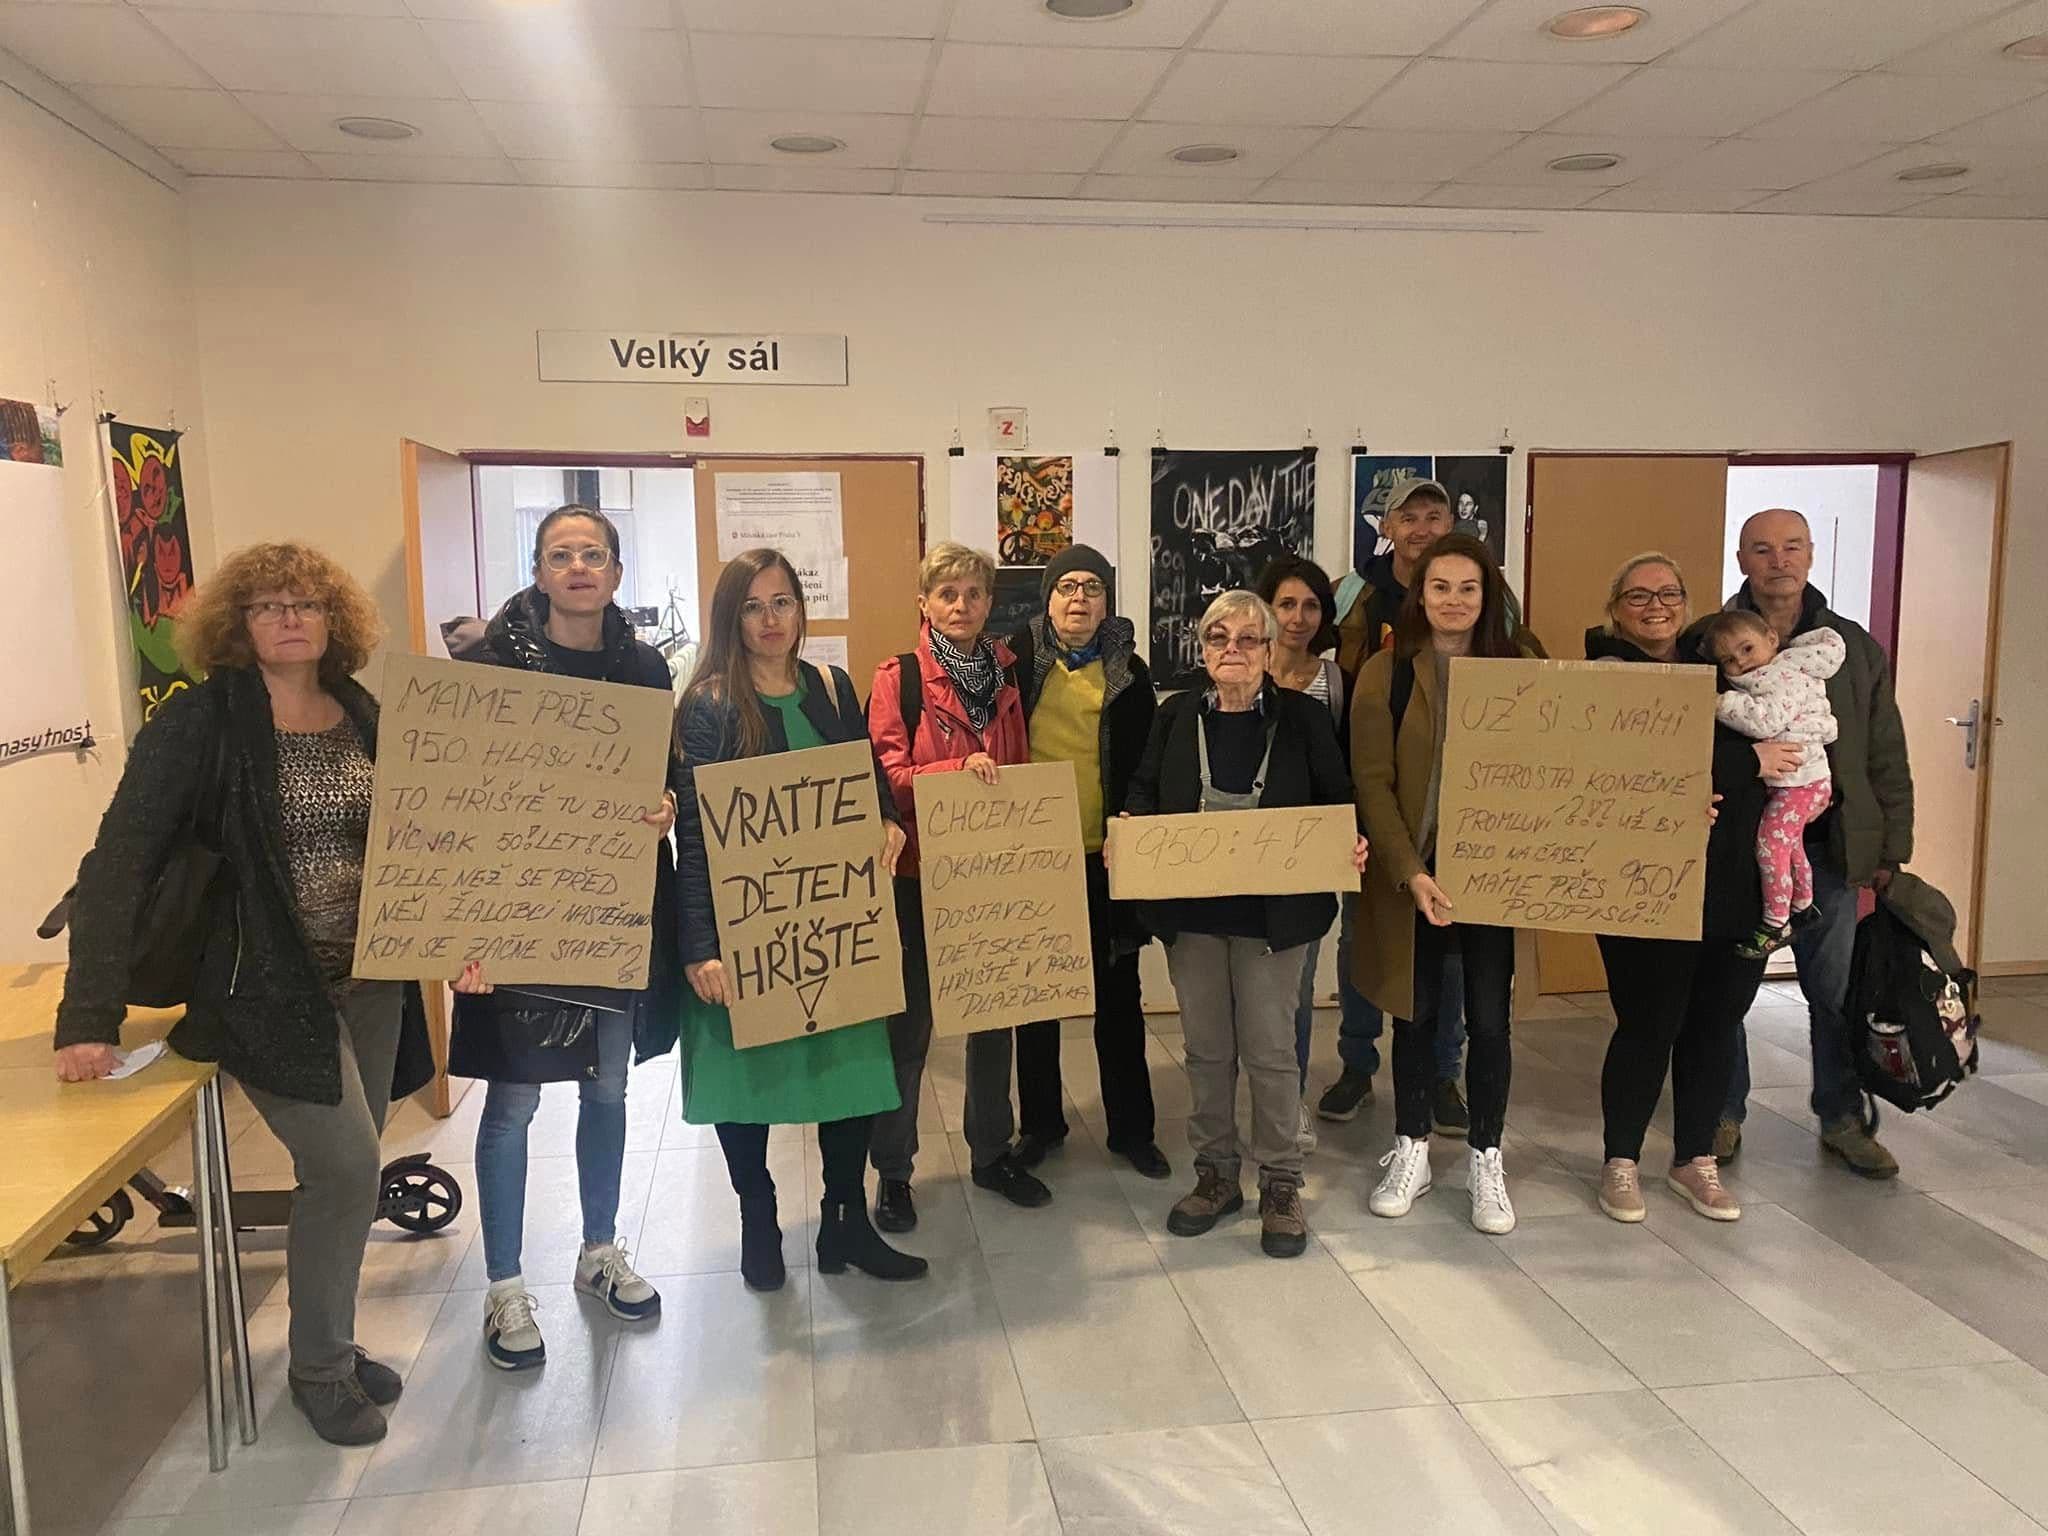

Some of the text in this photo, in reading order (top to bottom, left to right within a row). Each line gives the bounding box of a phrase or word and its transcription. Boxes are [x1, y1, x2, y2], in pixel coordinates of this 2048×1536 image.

[610, 338, 778, 377] Velký sál
[1001, 421, 1013, 435] Z
[1460, 680, 1535, 732] UŽ
[1538, 695, 1562, 733] SI
[1571, 704, 1597, 732] S
[0, 719, 91, 758] nasytnost
[402, 729, 467, 763] 950
[1465, 761, 1574, 792] STAROSTA
[390, 786, 427, 811] TO
[557, 795, 586, 814] TU
[592, 799, 648, 824] BYLO
[701, 772, 871, 850] VRAŤTE
[928, 796, 1063, 836] CHCEME
[1618, 806, 1655, 831] UŽ
[1654, 816, 1686, 837] BY
[931, 844, 1071, 890] OKAMŽITOU
[1451, 841, 1496, 861] BYLO
[1505, 846, 1531, 861] NA
[515, 868, 552, 887] SE
[722, 856, 876, 926] DĚTEM
[934, 900, 1056, 936] DOSTAVBU
[419, 936, 456, 959] SE
[463, 933, 543, 961] ZAČNE
[732, 907, 882, 1000] HŘIŠTĚ
[1025, 958, 1040, 978] V
